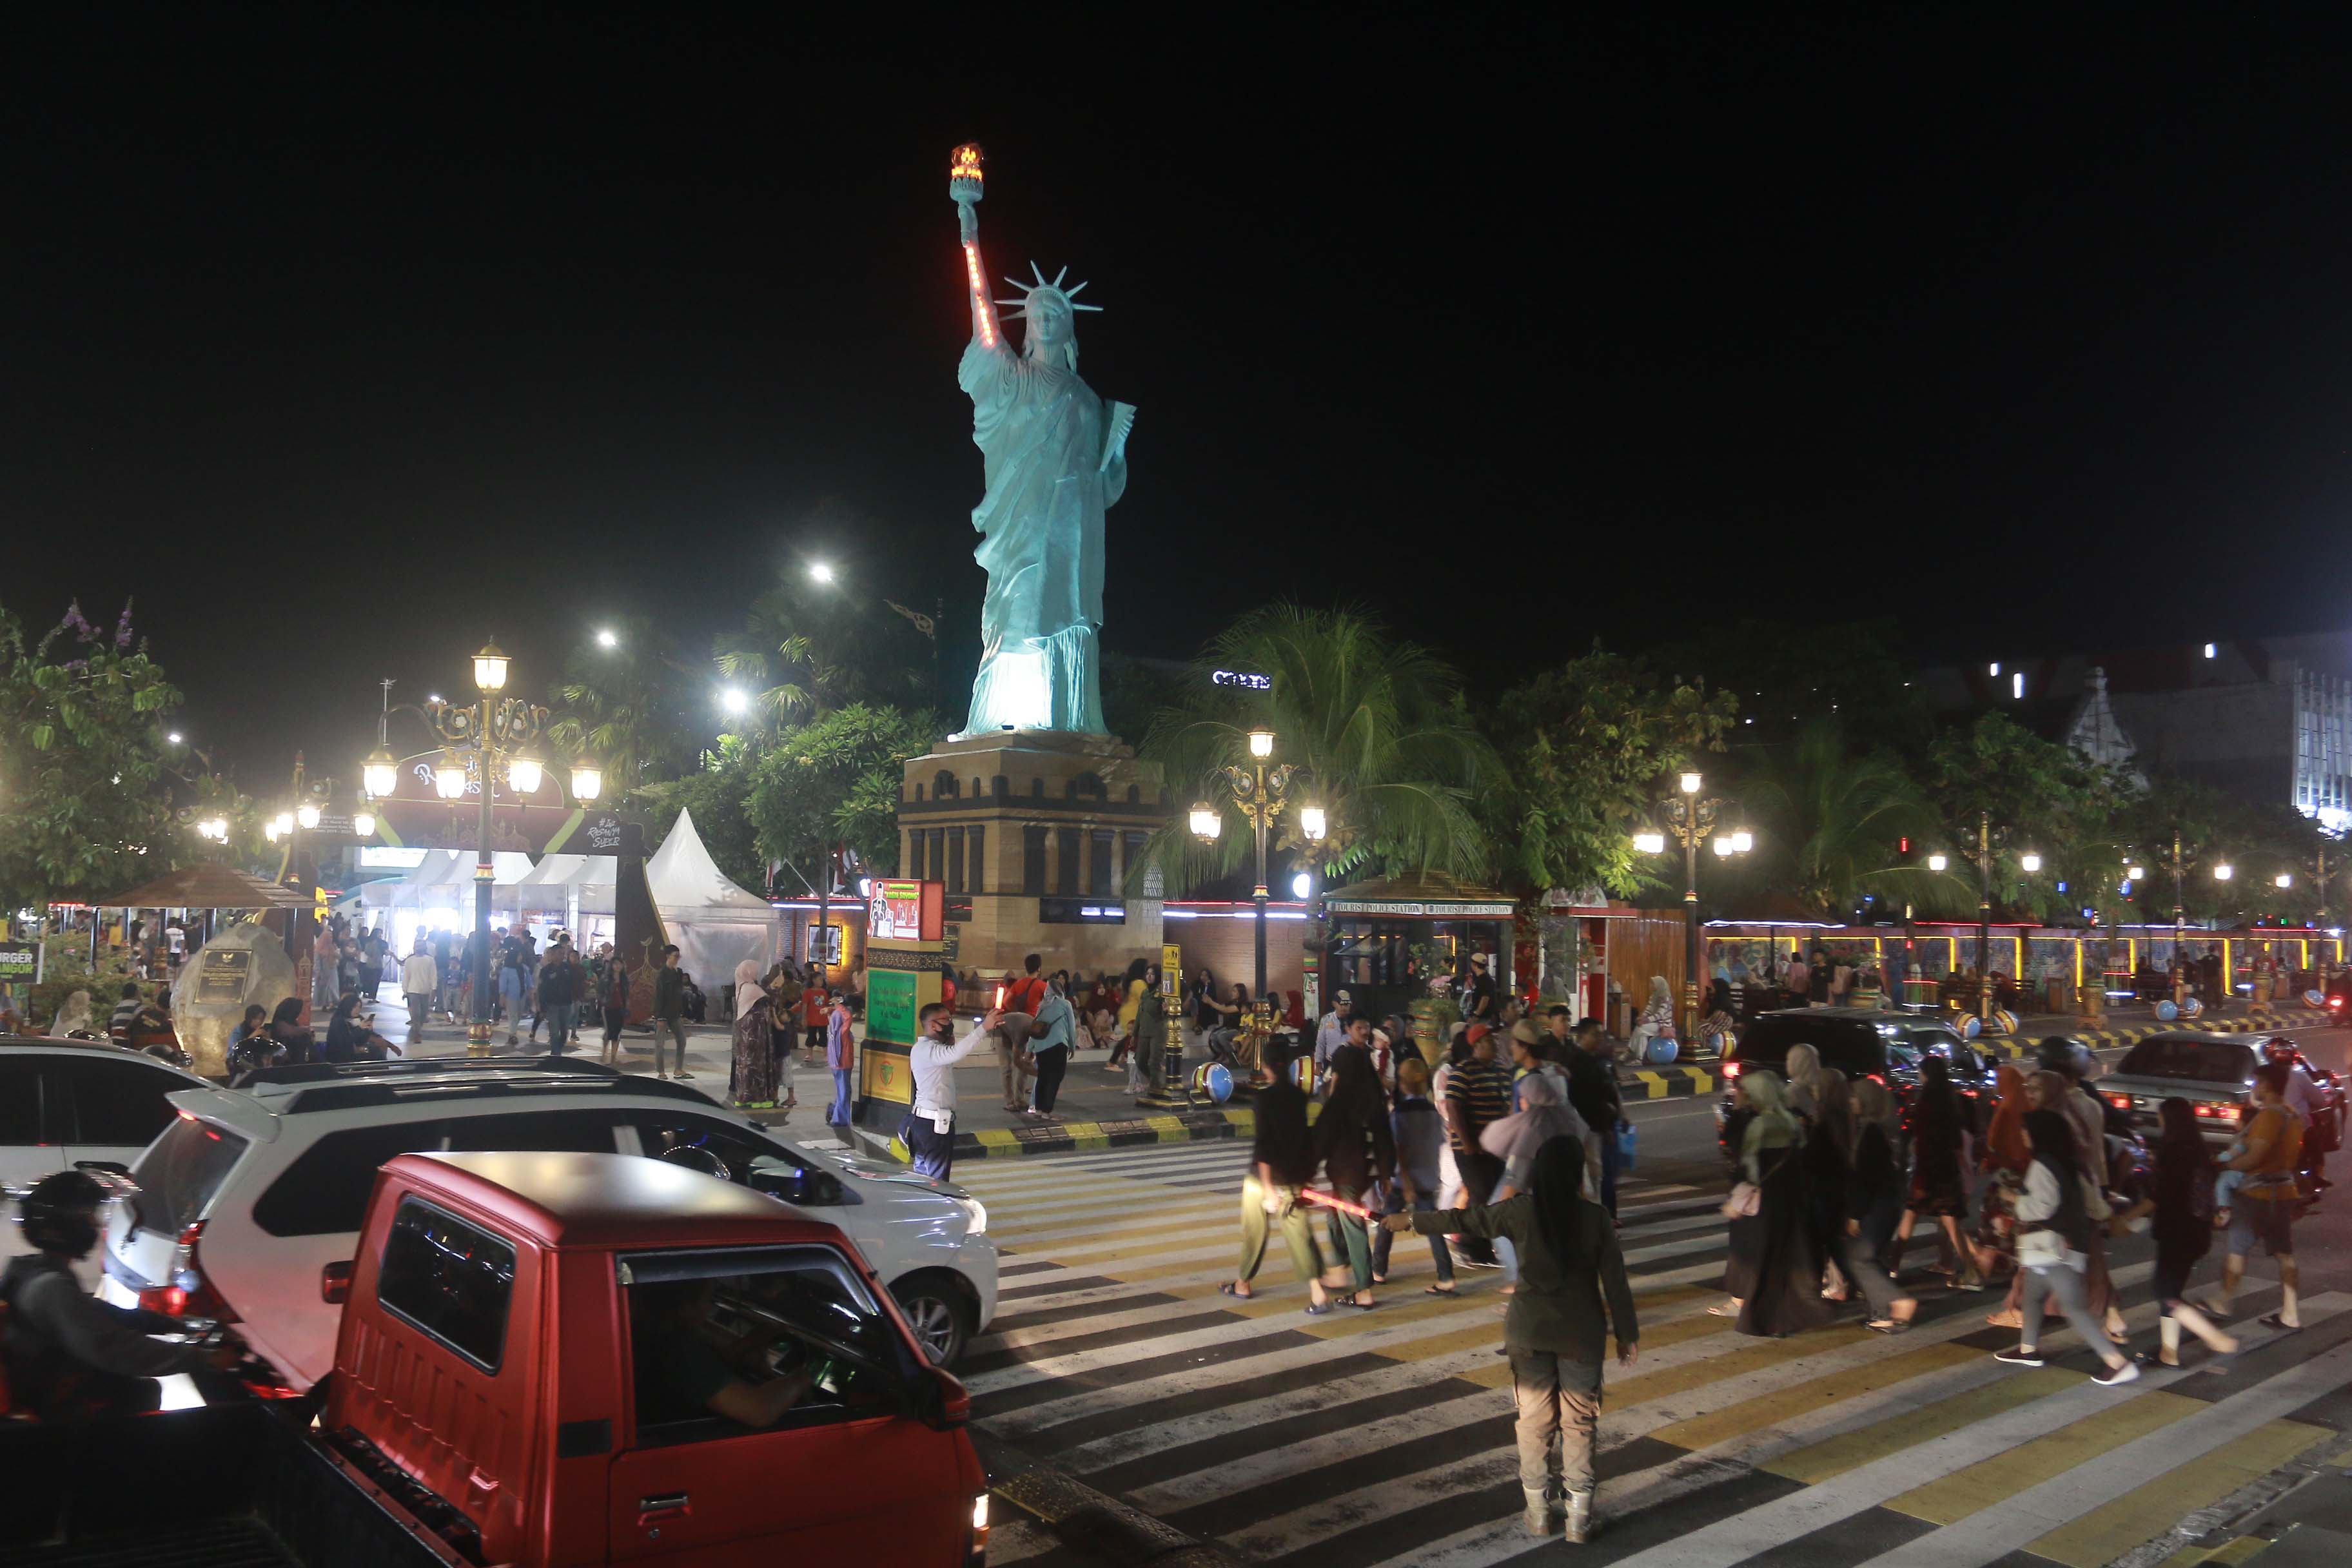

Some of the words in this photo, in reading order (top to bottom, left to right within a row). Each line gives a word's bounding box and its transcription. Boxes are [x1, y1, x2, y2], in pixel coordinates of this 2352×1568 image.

[593, 837, 620, 848] SUPER
[1338, 903, 1364, 912] TOURIST
[1366, 904, 1389, 913] POLICE
[1391, 904, 1420, 913] STATION
[1435, 905, 1461, 914] TOURIST
[1462, 905, 1483, 914] POLICE
[1485, 905, 1509, 914] STATION
